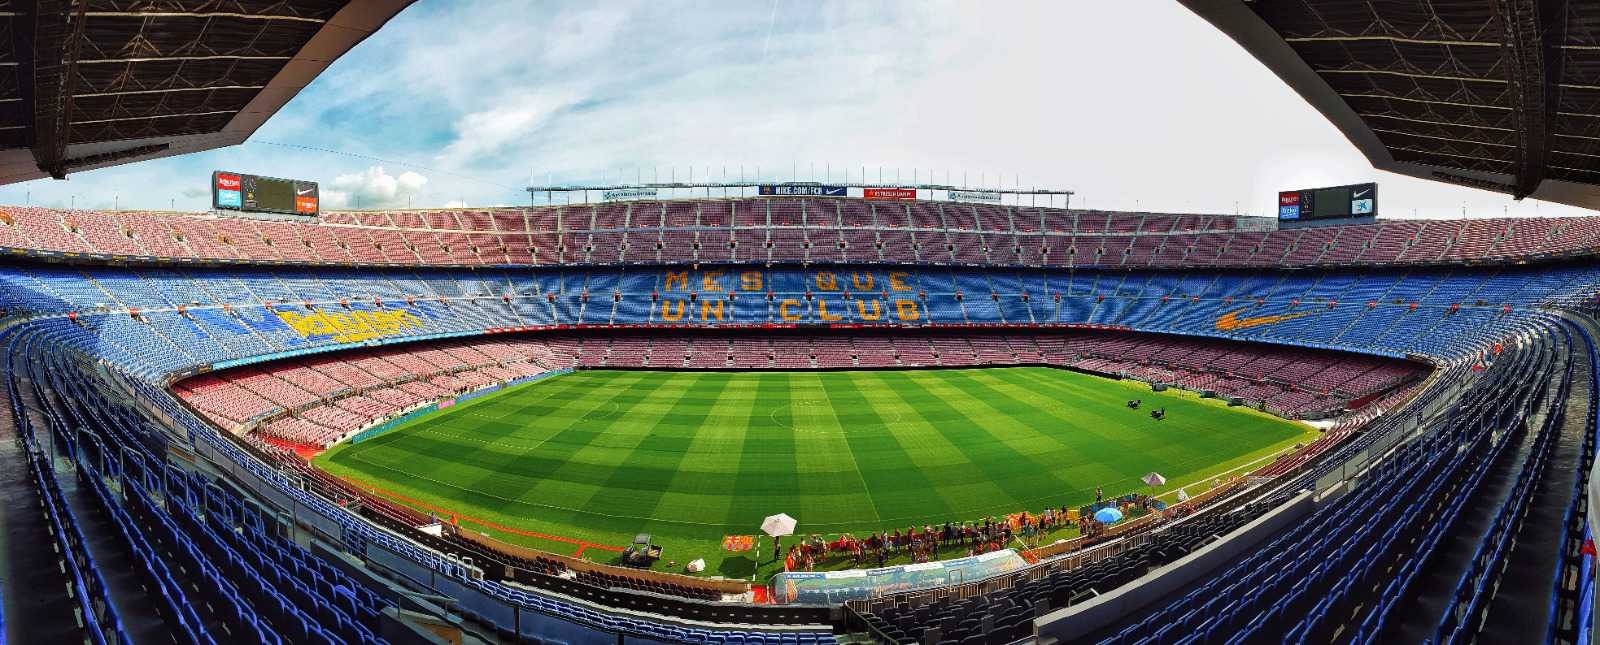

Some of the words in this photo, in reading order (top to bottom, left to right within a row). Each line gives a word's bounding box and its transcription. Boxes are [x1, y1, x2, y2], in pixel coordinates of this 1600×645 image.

[664, 271, 763, 292] MES
[815, 271, 912, 291] QUE
[662, 299, 724, 321] UN
[780, 298, 920, 321] CLUB
